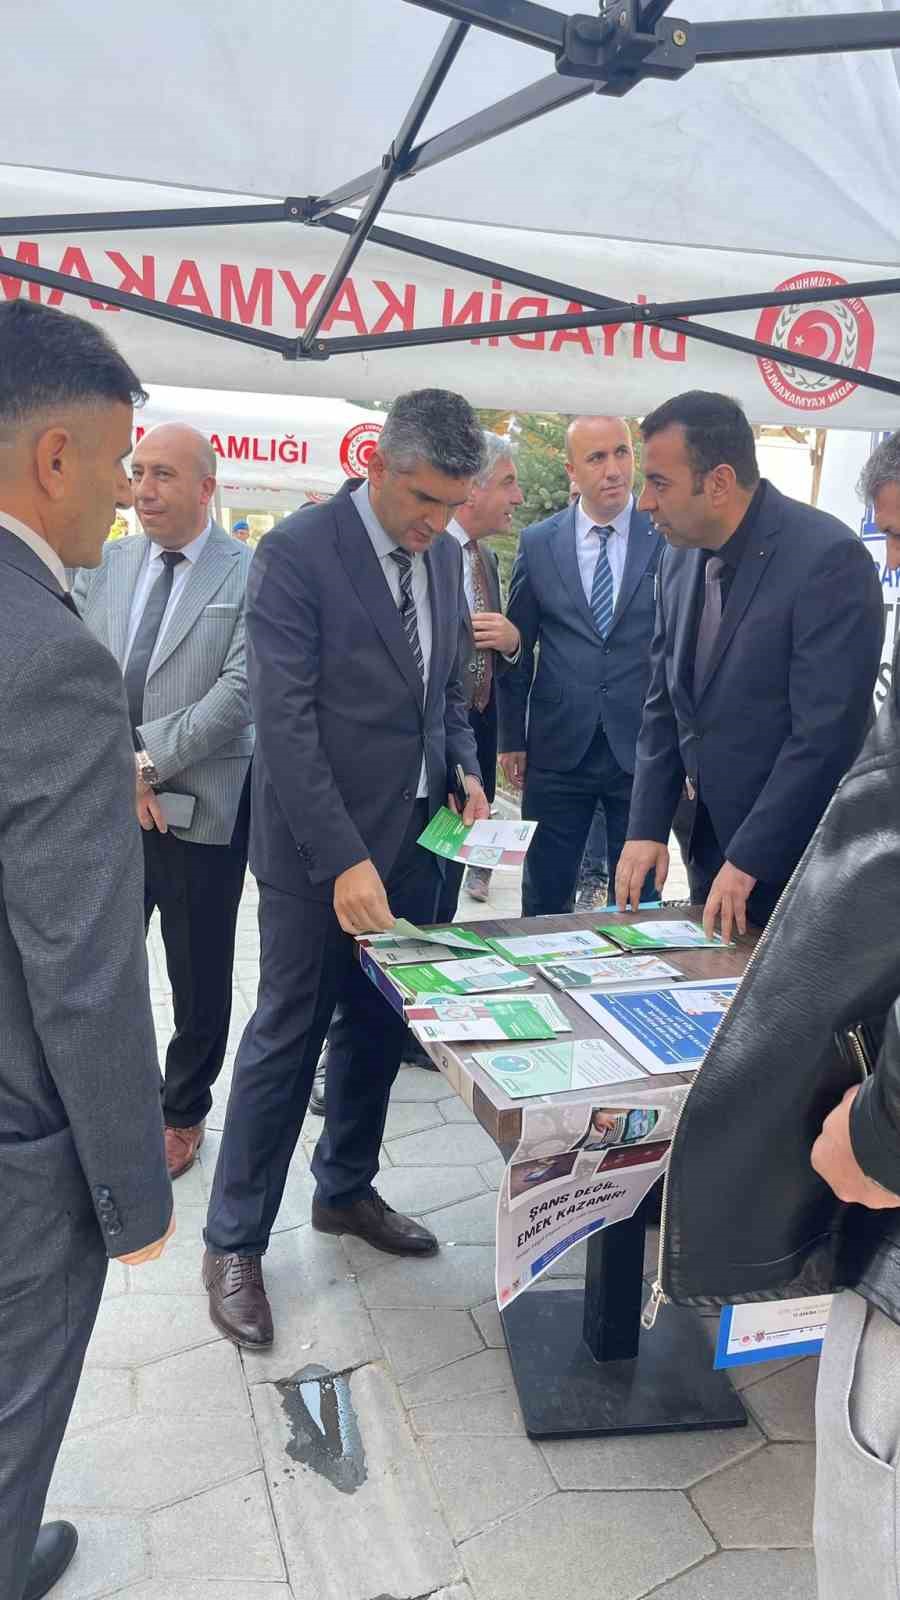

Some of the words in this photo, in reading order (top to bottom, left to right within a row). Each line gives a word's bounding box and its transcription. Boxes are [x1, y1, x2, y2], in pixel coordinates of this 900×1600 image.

[210, 433, 307, 465] AMLIĞI
[517, 1216, 552, 1247] EMEK
[556, 1190, 627, 1220] KAZANIR!
[529, 1193, 570, 1222] ŞANS
